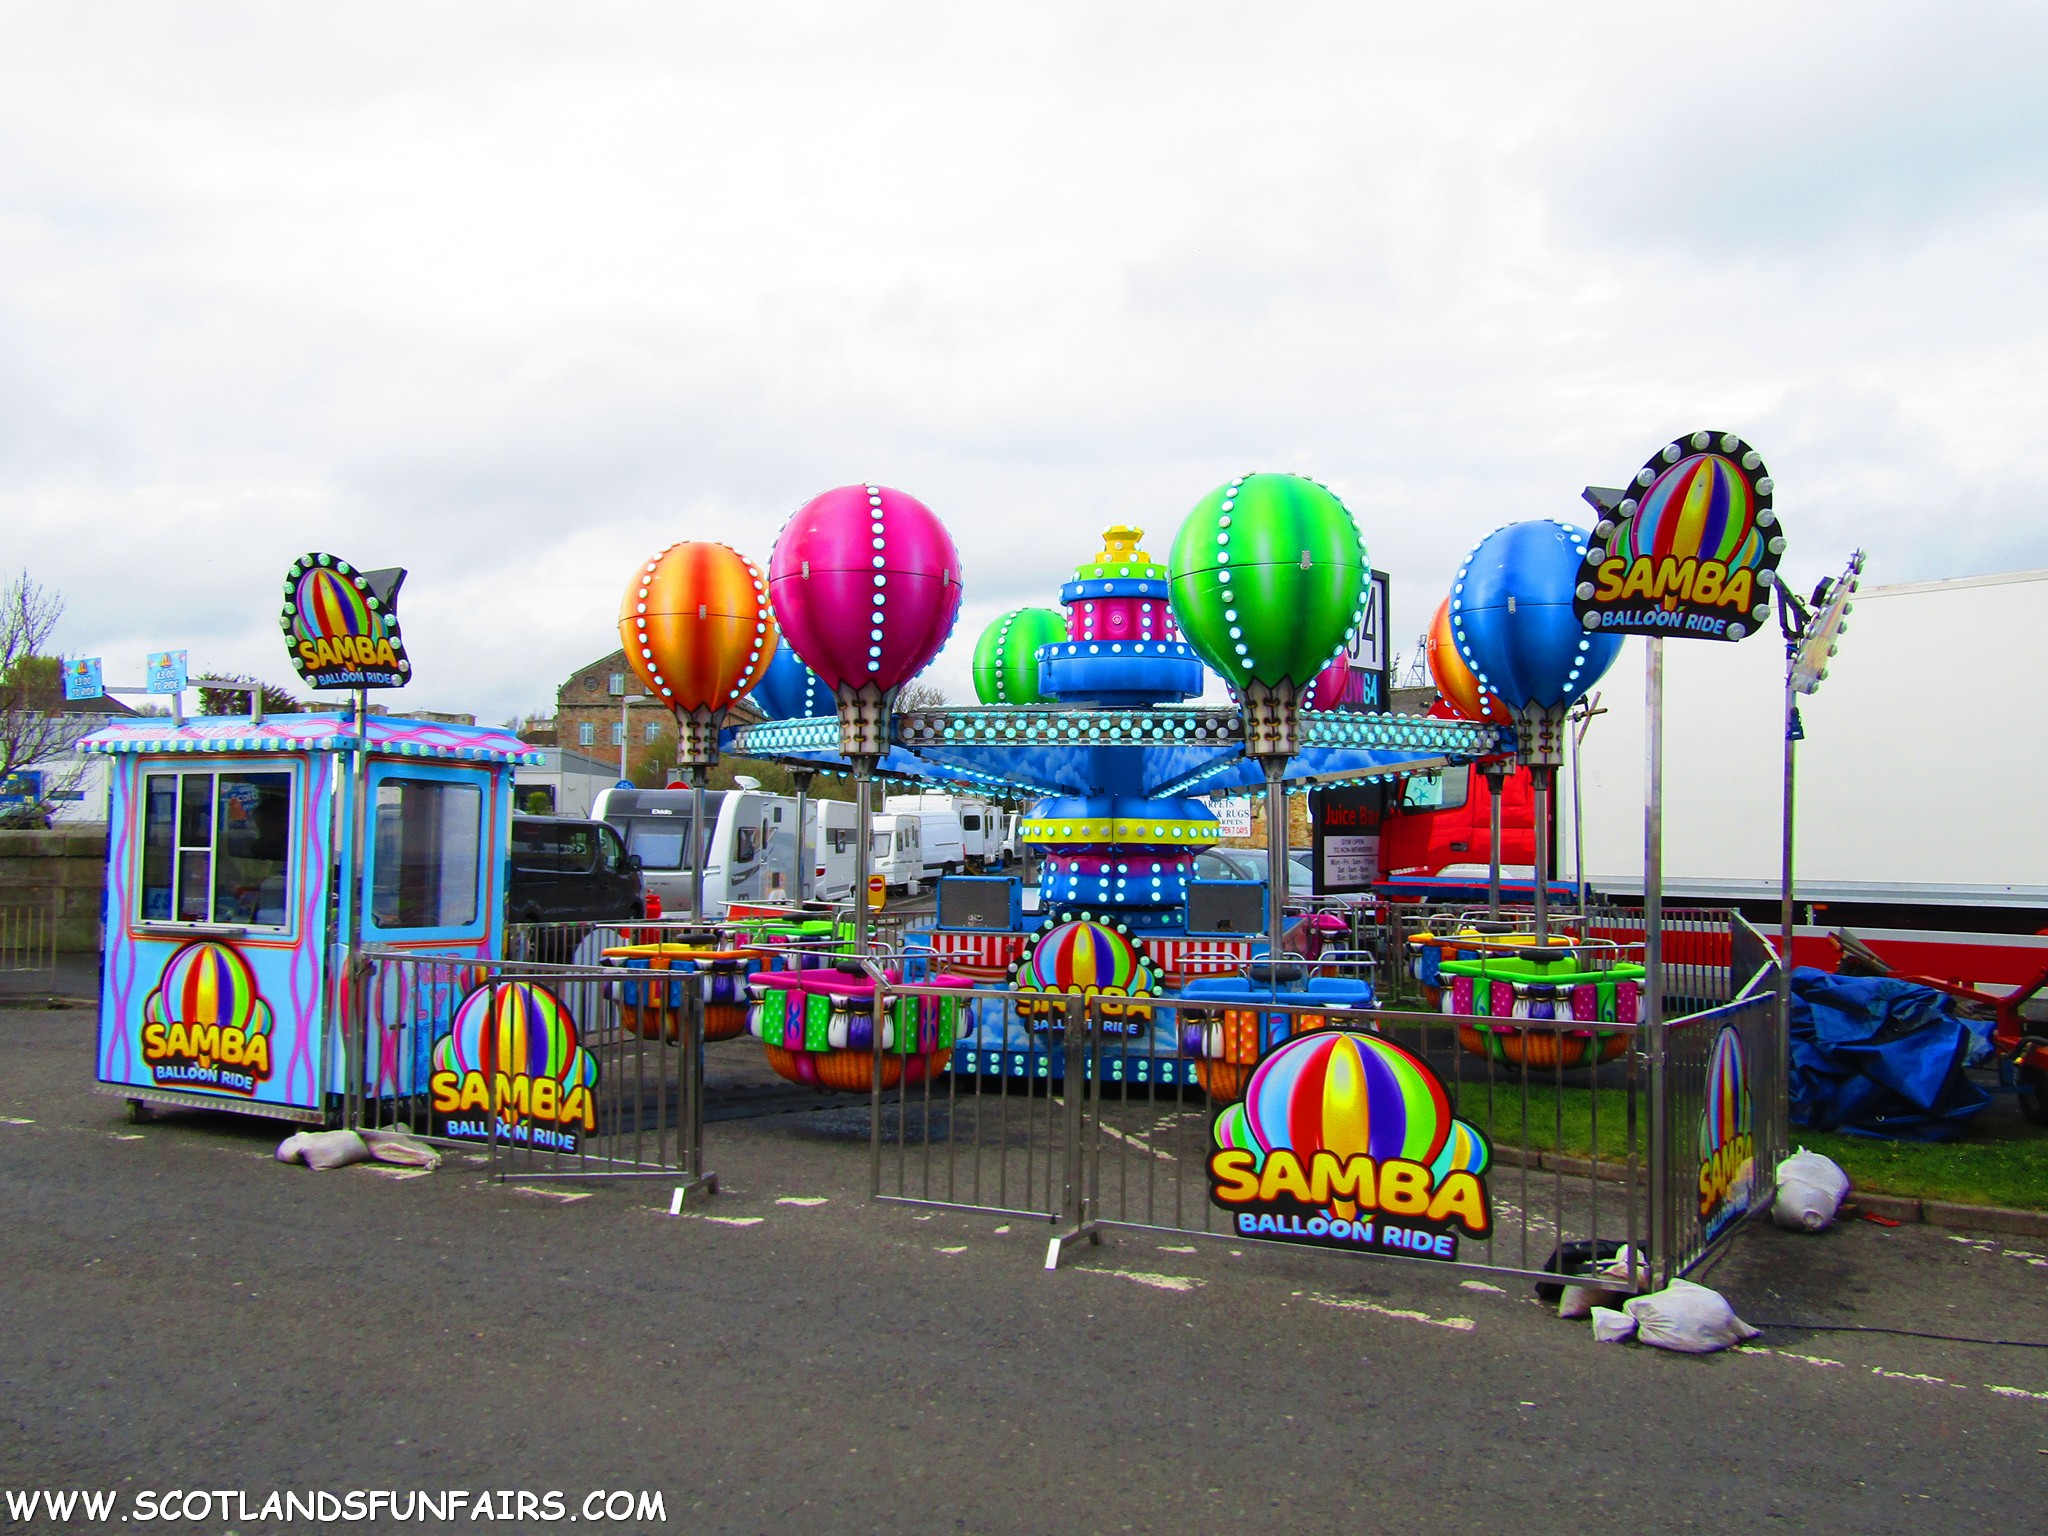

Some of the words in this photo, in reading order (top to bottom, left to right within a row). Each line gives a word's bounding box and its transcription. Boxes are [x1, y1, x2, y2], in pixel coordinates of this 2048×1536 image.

[1595, 557, 1753, 613] SAMBA
[1601, 610, 1684, 627] BALLOON
[1685, 612, 1726, 635] RIDE
[299, 635, 399, 670] SAMBA
[153, 682, 161, 690] TO
[163, 680, 179, 689] RIDE
[318, 671, 364, 686] BALLOON
[367, 672, 392, 684] RIDE
[72, 688, 80, 696] TO
[81, 687, 95, 696] RIDE
[1226, 810, 1250, 818] RUGS
[1325, 804, 1357, 825] Juice
[1360, 805, 1380, 825] Bar
[1103, 1021, 1138, 1034] RIDE
[145, 1022, 269, 1072] SAMBA
[156, 1066, 218, 1082] BALLOON
[221, 1071, 254, 1090] RIDE
[431, 1071, 596, 1131] SAMBA
[533, 1127, 576, 1150] RIDE
[1212, 1149, 1488, 1231] SAMBA
[1238, 1212, 1375, 1243] BALLOON
[1383, 1225, 1455, 1256] RIDE
